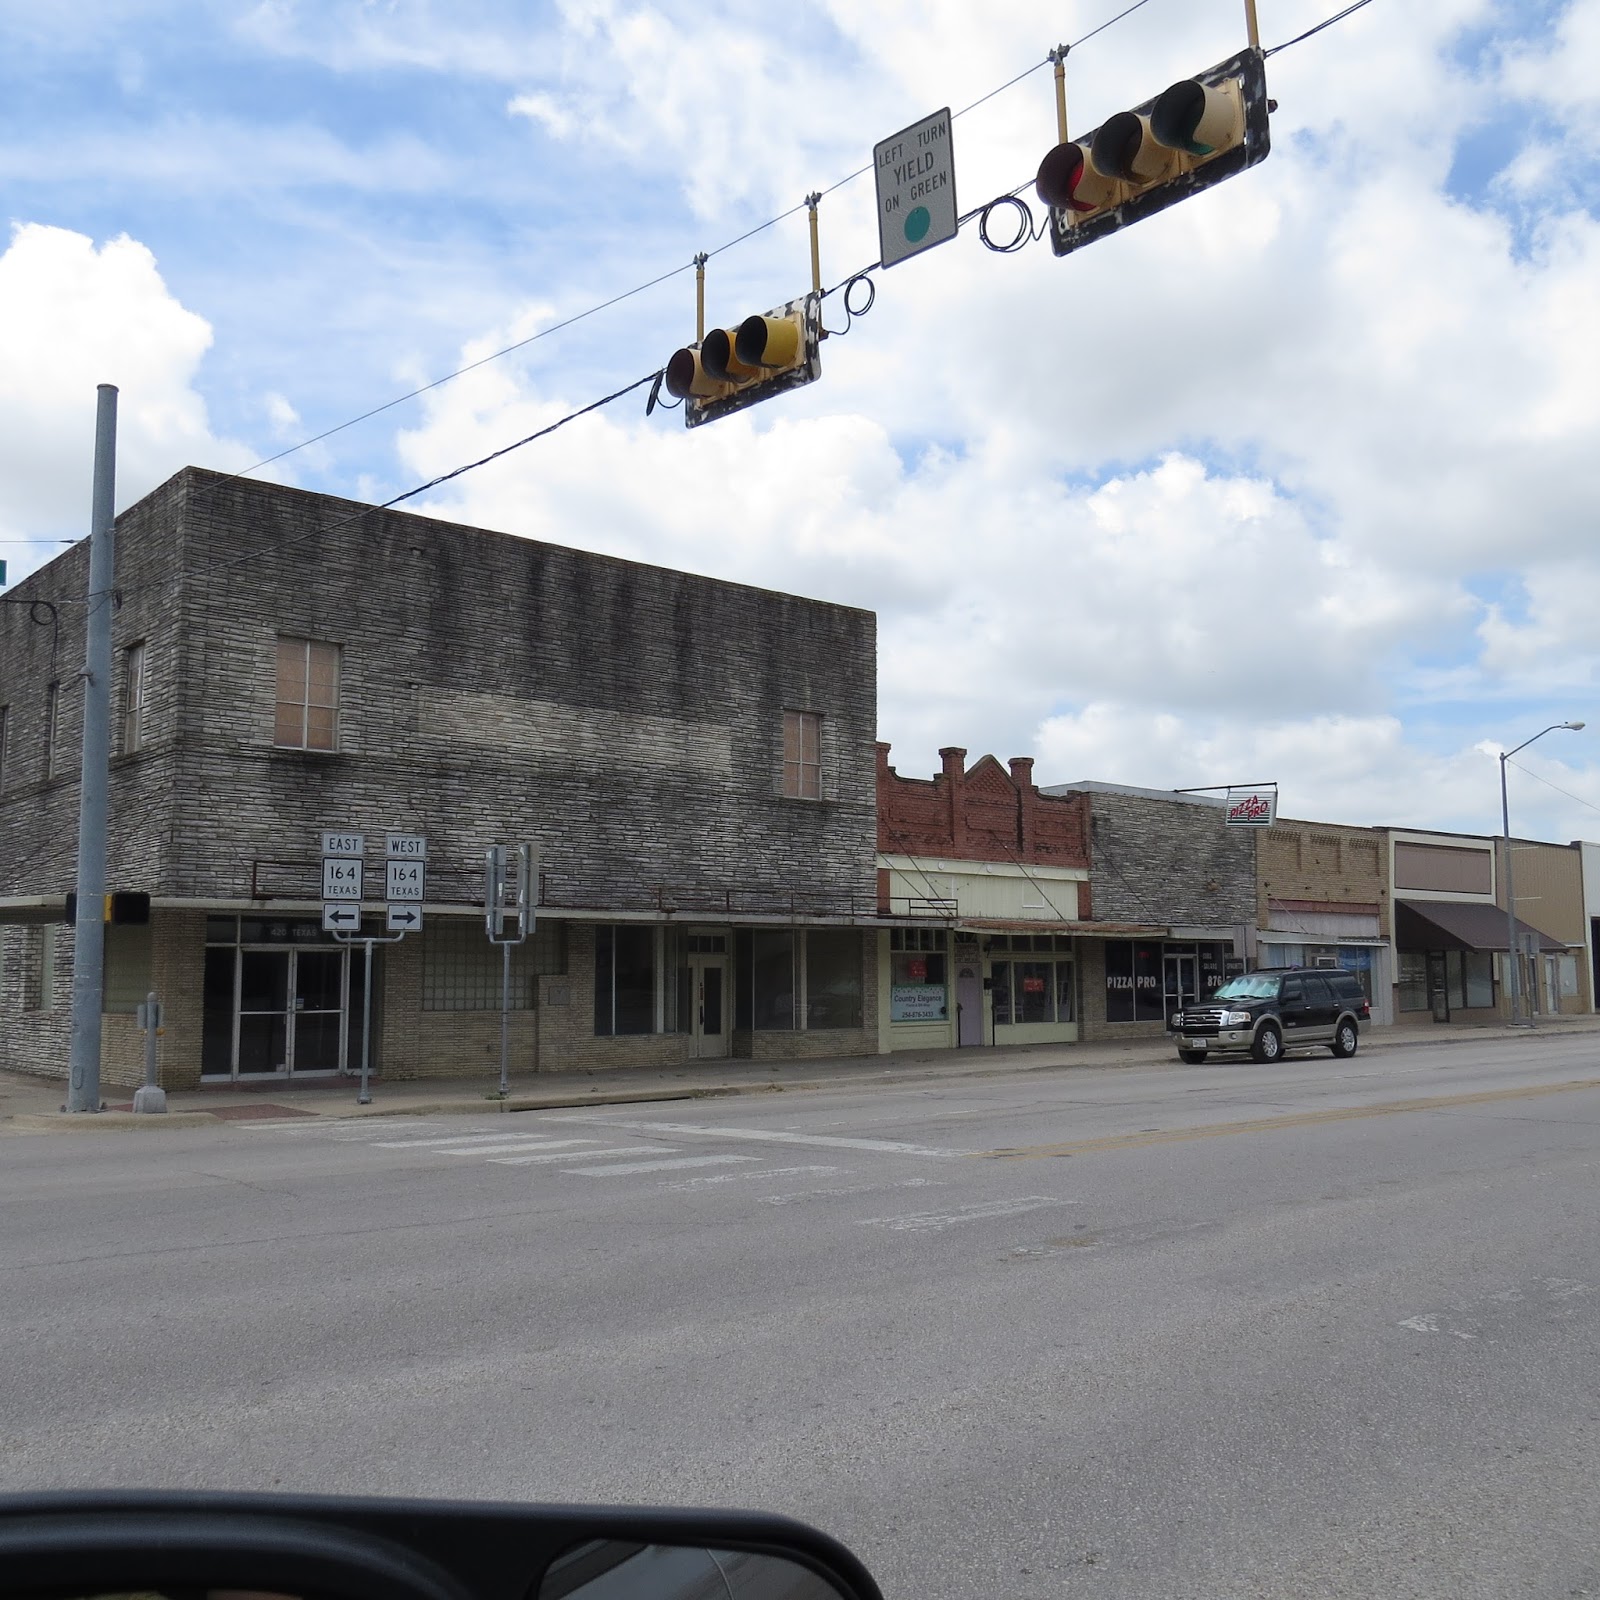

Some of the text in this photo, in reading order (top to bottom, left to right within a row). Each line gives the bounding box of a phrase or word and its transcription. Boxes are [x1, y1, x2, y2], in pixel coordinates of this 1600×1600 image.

[879, 121, 946, 168] LEFT TURN
[893, 151, 934, 186] YIELD
[885, 171, 947, 213] ON GREEN
[1230, 794, 1259, 820] PIZZA
[1247, 801, 1268, 821] PRO
[329, 837, 358, 851] EAST
[391, 840, 421, 853] WEST
[330, 866, 355, 880] 164
[393, 867, 417, 881] 164
[328, 885, 358, 895] TEXAS
[391, 886, 420, 896] TEXAS
[271, 928, 318, 937] 420 TEXAS
[1106, 975, 1156, 989] PIZZA PRO
[894, 994, 942, 1003] Country Elegance
